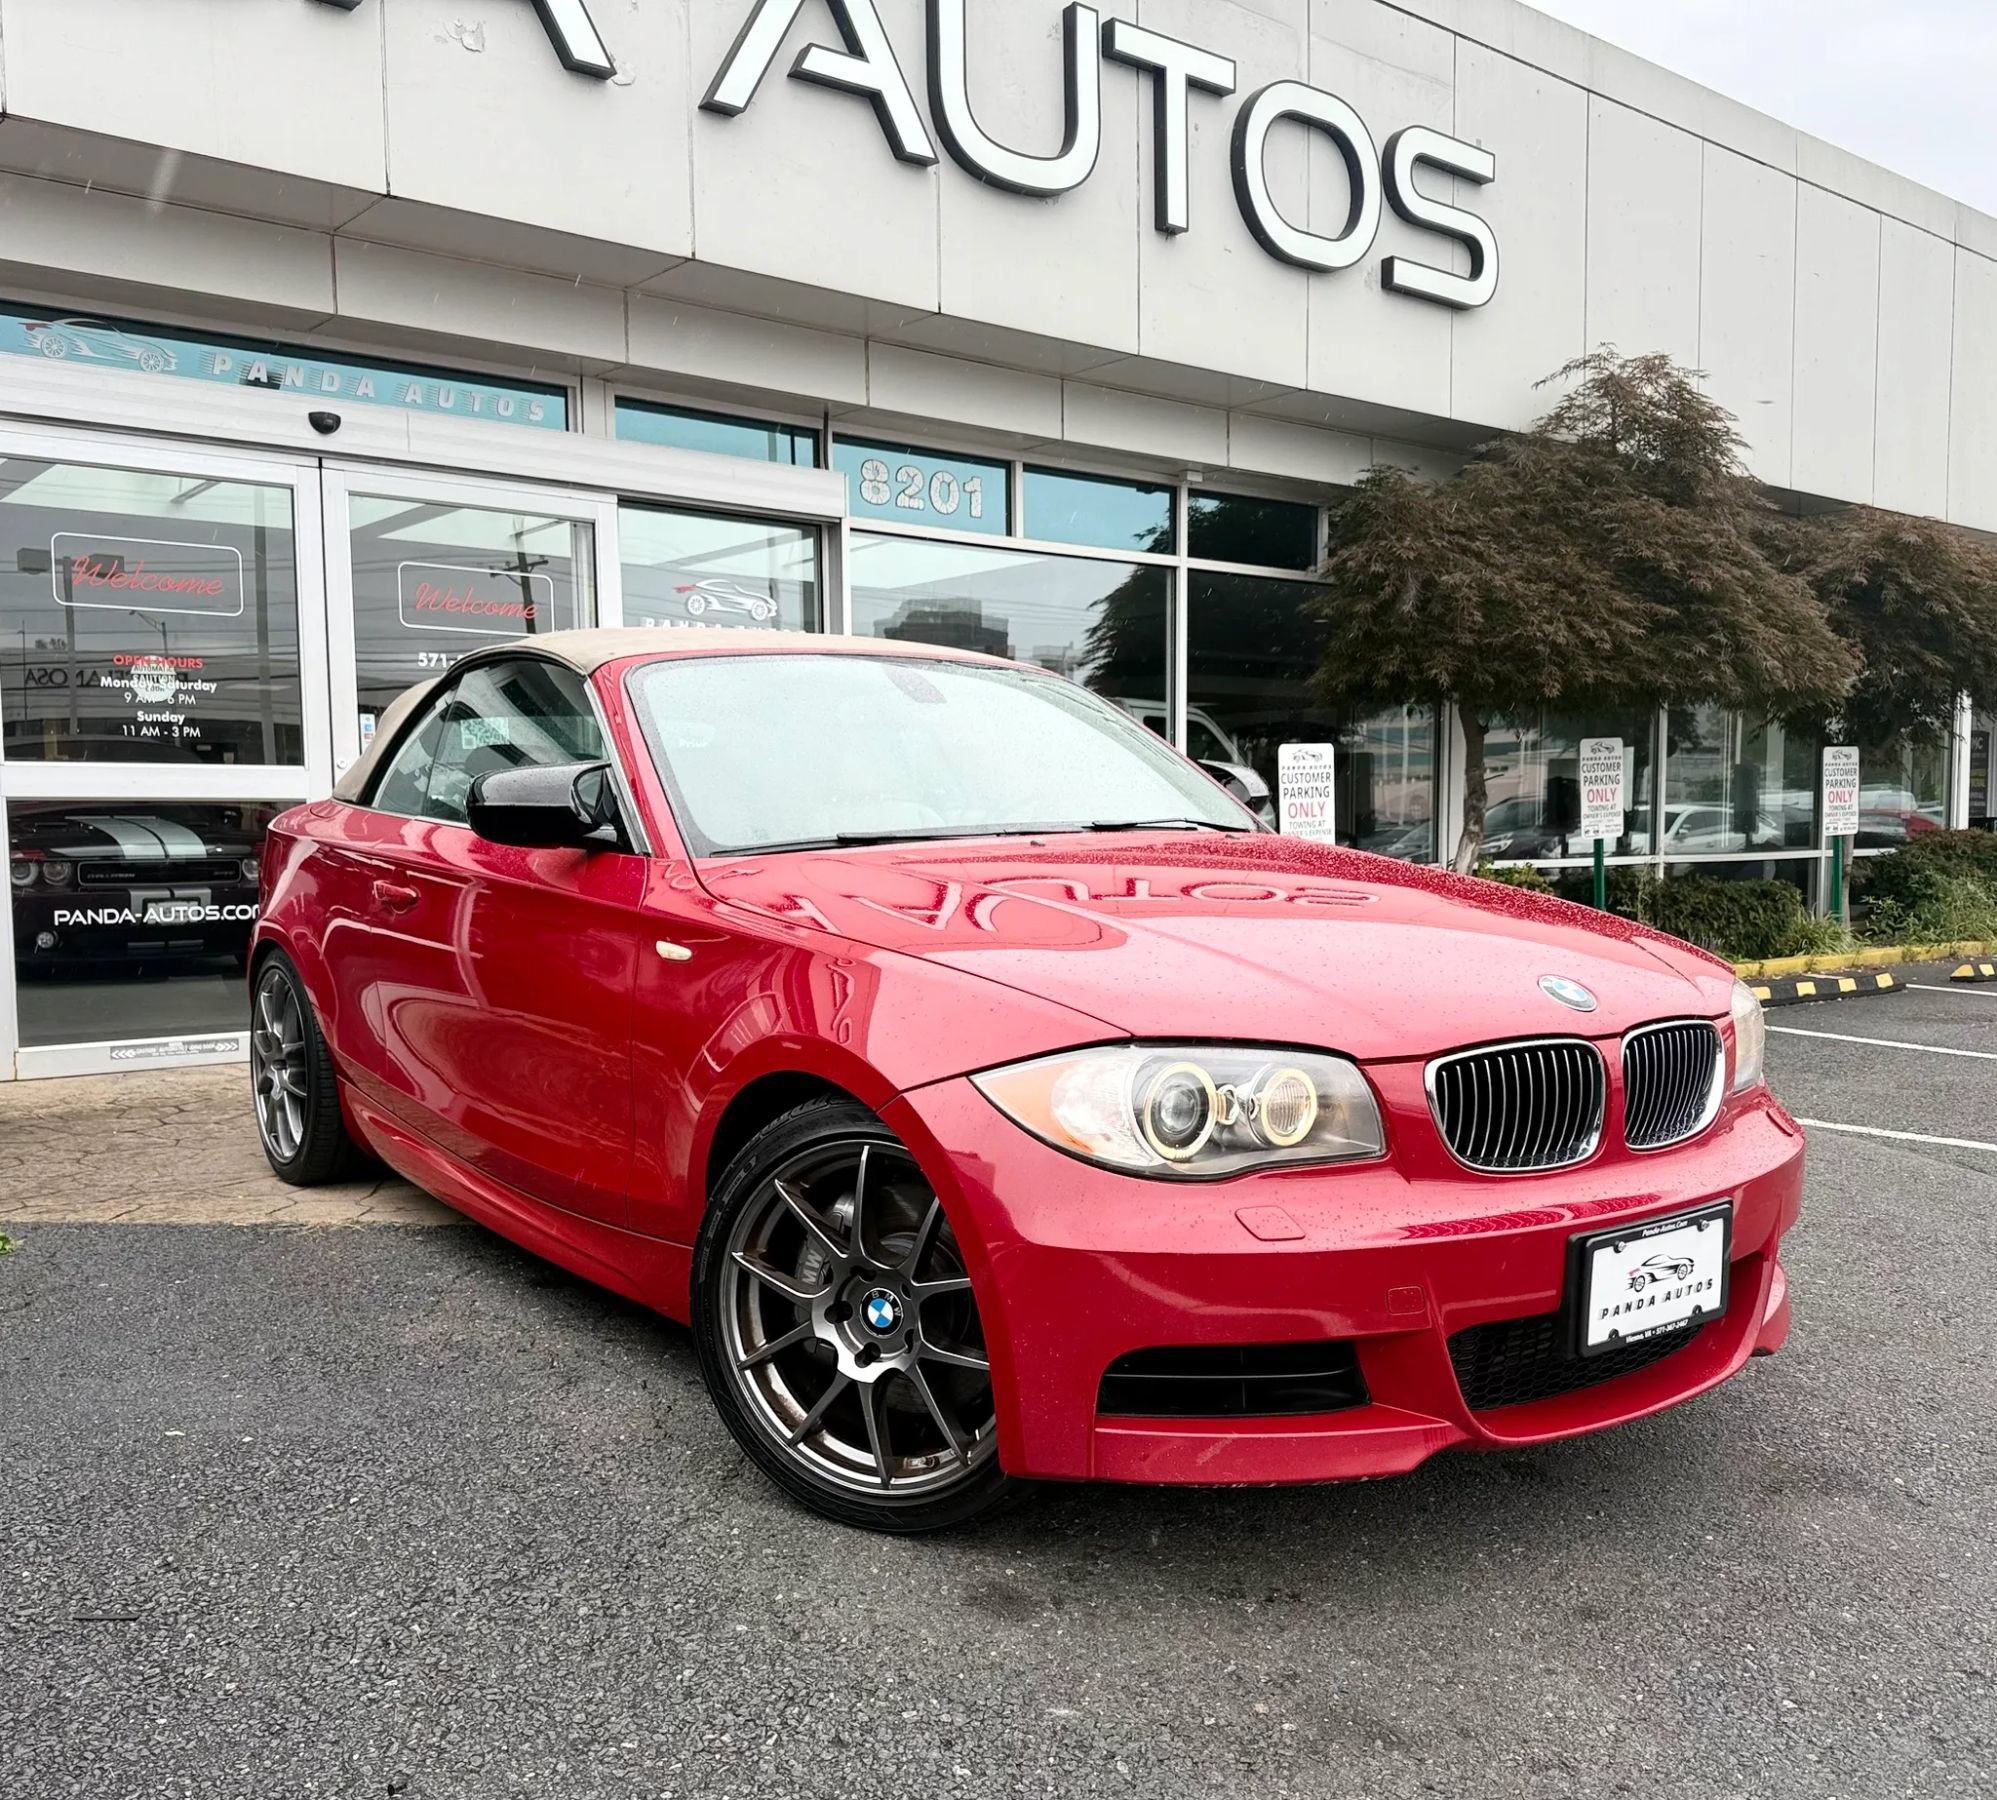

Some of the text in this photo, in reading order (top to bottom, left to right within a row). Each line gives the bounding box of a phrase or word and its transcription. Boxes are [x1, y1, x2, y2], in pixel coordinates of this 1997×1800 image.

[699, 0, 1499, 309] AUTOS
[212, 351, 546, 421] PANDA AUTOS
[859, 457, 983, 519] 8201
[71, 554, 225, 596] Welcome
[414, 582, 540, 620] Welcome
[113, 655, 204, 670] OPEN HOURS
[100, 676, 217, 694] Monday-Saturday
[124, 692, 132, 704] 9
[167, 694, 175, 705] 6
[178, 693, 196, 705] PM
[136, 711, 186, 725] Sunday
[122, 725, 136, 737] 11
[140, 726, 161, 737] AM
[171, 726, 180, 737] 3
[183, 726, 201, 738] PM
[1581, 762, 1622, 774] CUSTOMER
[1824, 767, 1858, 778] CUSTOMER
[1280, 771, 1332, 785] CUSTOMER
[1583, 774, 1621, 788] PARKING
[1825, 778, 1857, 789] PARKING
[1283, 785, 1330, 800] PARKING
[1586, 788, 1617, 804] ONLY
[1828, 790, 1854, 804] ONLY
[1288, 801, 1326, 819] ONLY
[1289, 820, 1326, 830] TOWING AT
[871, 1290, 901, 1317] BMW
[1601, 1278, 1713, 1319] PANDA AUTOS
